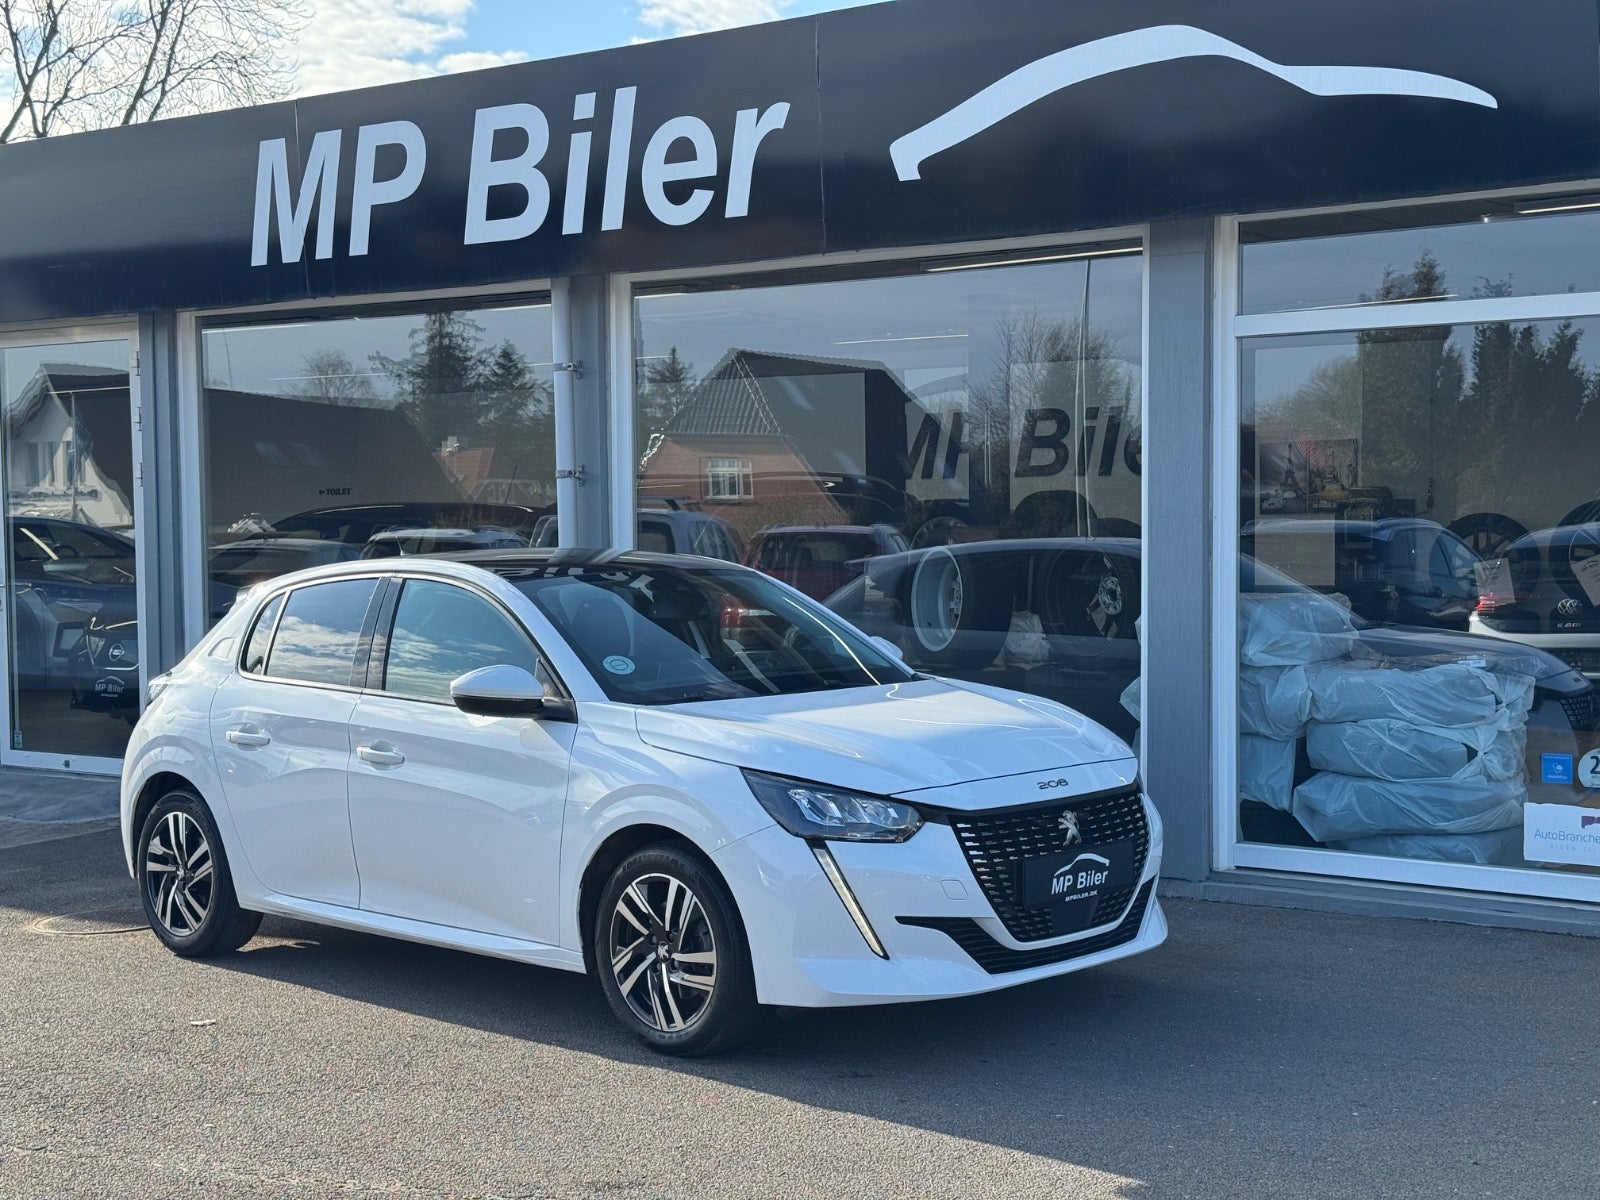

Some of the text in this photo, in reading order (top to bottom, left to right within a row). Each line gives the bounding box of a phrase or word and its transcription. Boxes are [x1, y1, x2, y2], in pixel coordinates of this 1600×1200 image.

[251, 86, 791, 267] MP Biler
[325, 487, 352, 496] TOILET
[1037, 779, 1068, 790] 208
[1051, 870, 1108, 895] MP Biler
